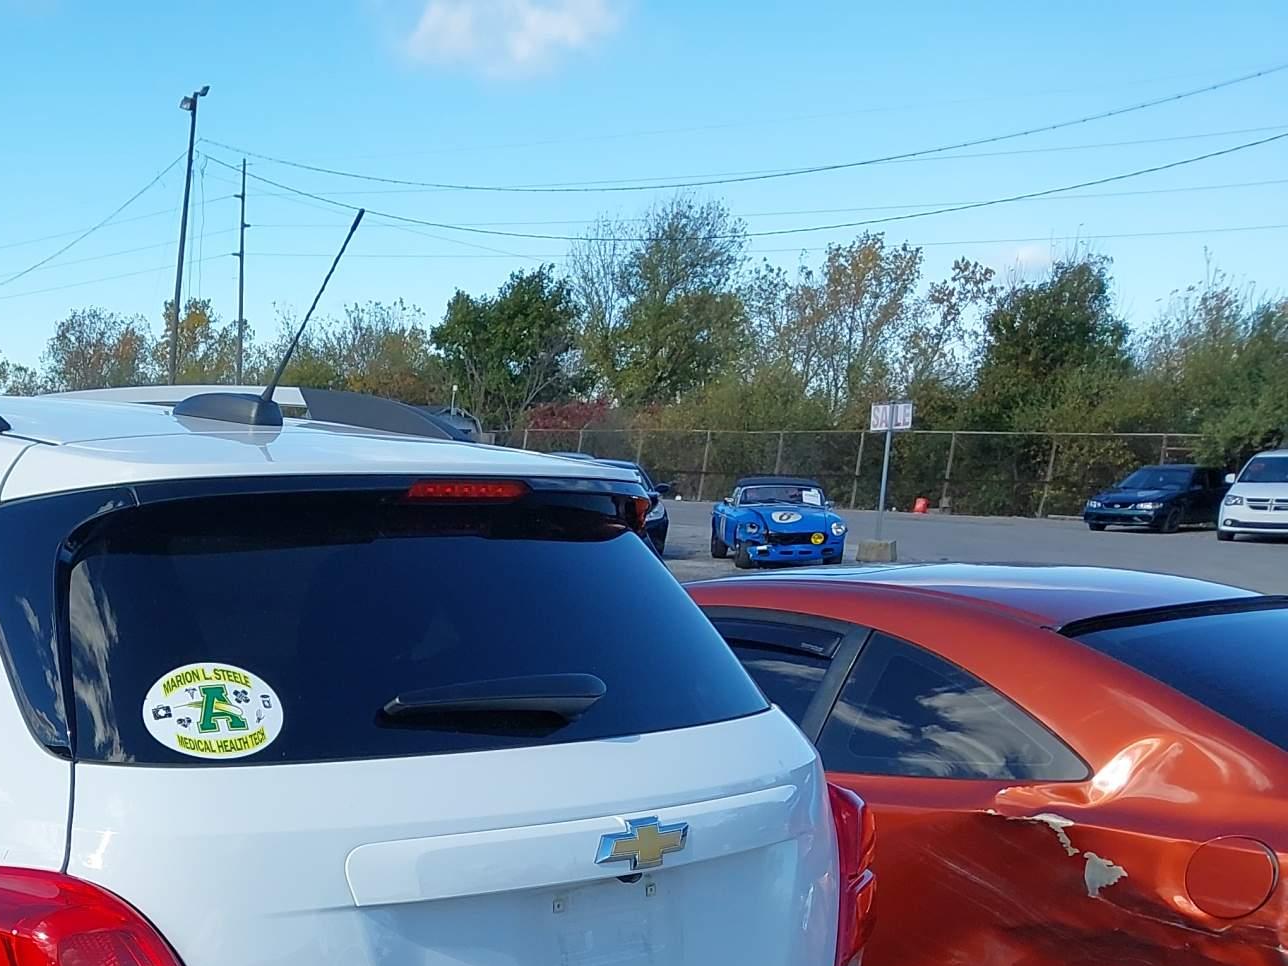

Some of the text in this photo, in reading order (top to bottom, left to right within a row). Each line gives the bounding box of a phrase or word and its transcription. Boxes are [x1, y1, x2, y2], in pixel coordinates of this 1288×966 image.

[872, 405, 910, 428] SALE
[162, 668, 201, 697] MARION
[213, 667, 251, 689] STEELE
[196, 683, 249, 734] A
[177, 728, 266, 753] MEDICAL HEALTH TECH
